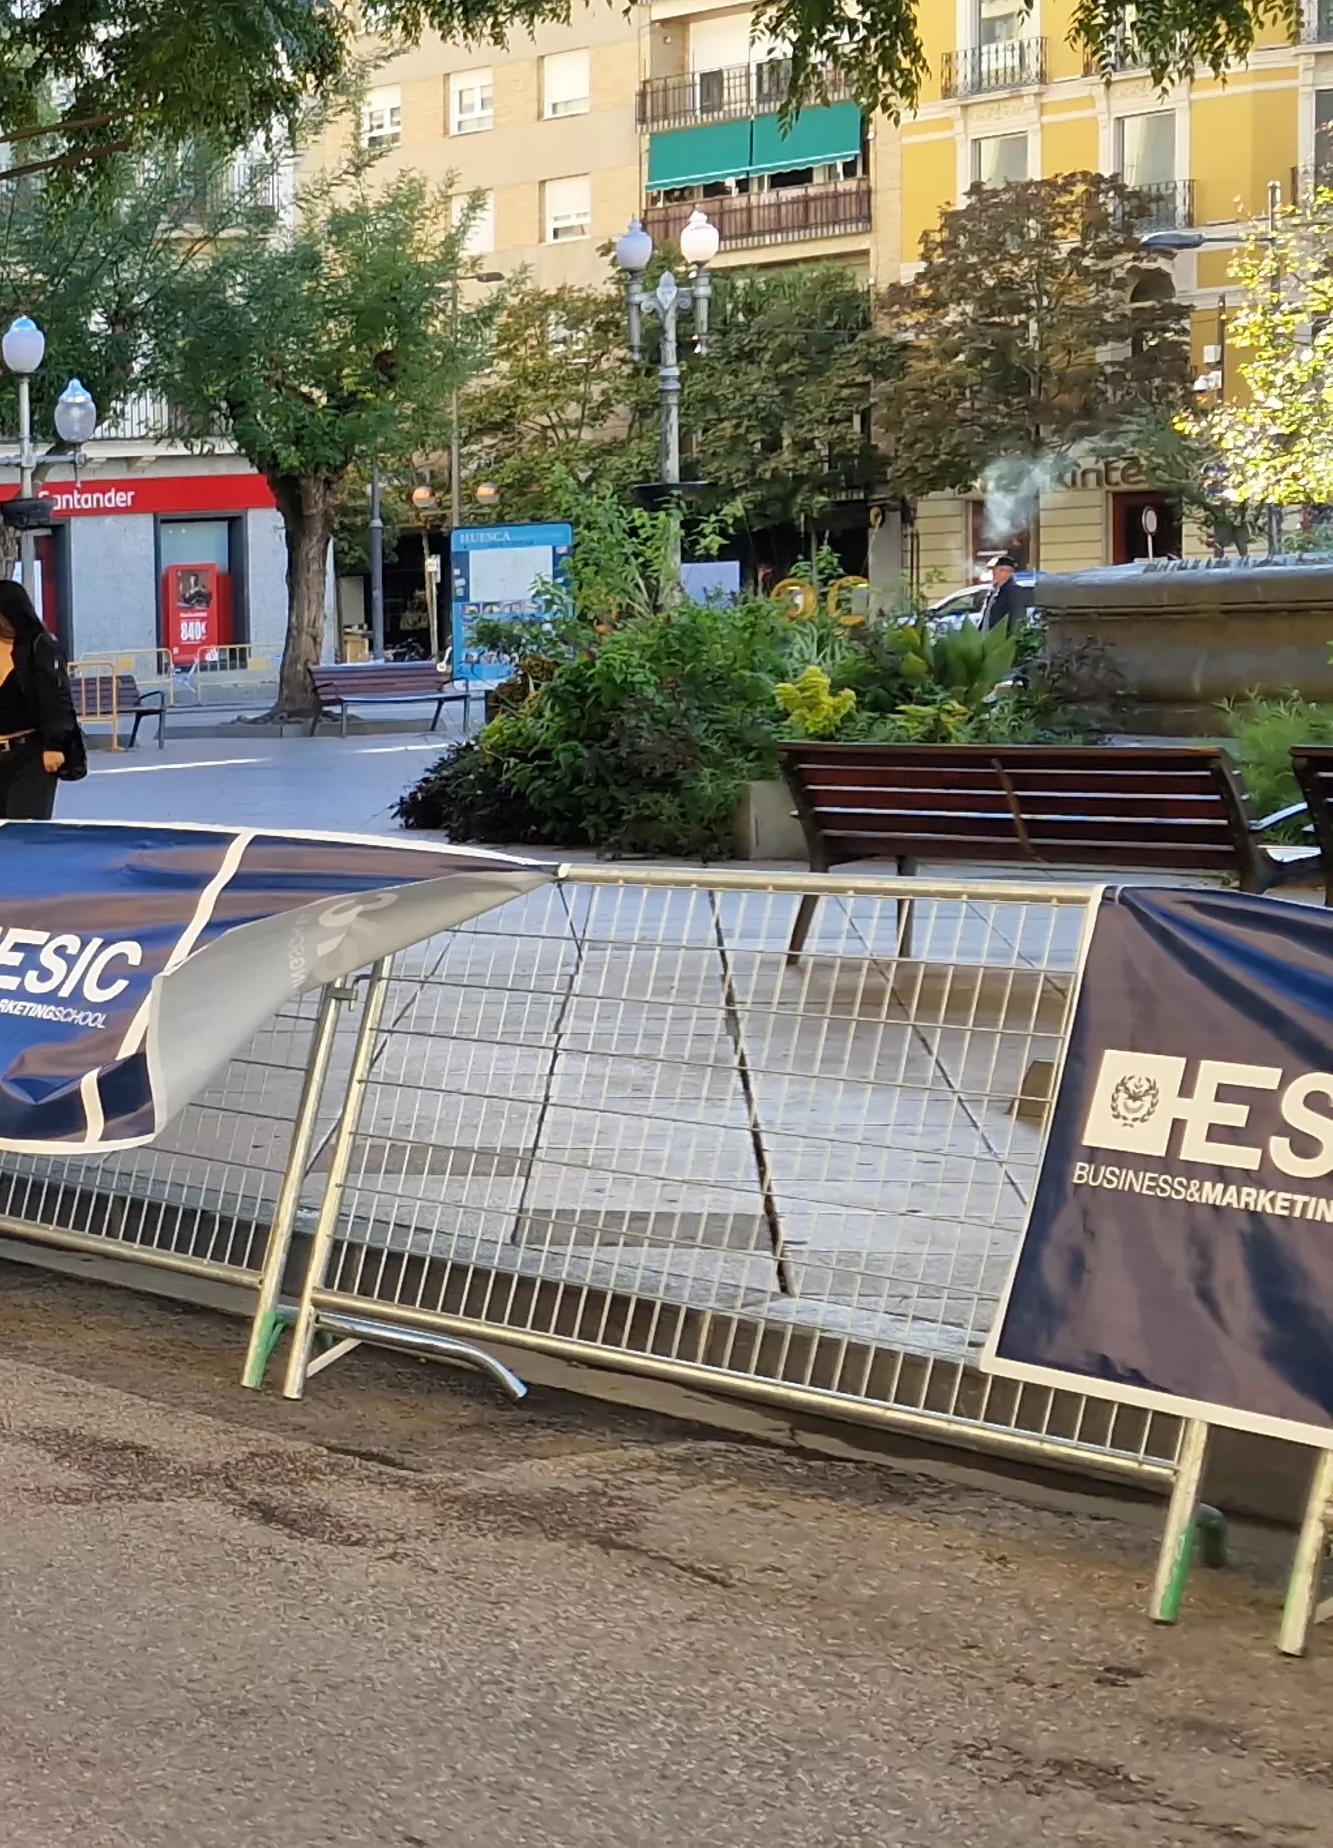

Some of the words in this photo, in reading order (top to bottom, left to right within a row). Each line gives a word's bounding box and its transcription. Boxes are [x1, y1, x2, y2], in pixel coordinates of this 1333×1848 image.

[459, 531, 511, 545] HUESCA
[1180, 1060, 1333, 1178] ES
[1072, 1161, 1333, 1223] BUSINESS&MARKETIN
